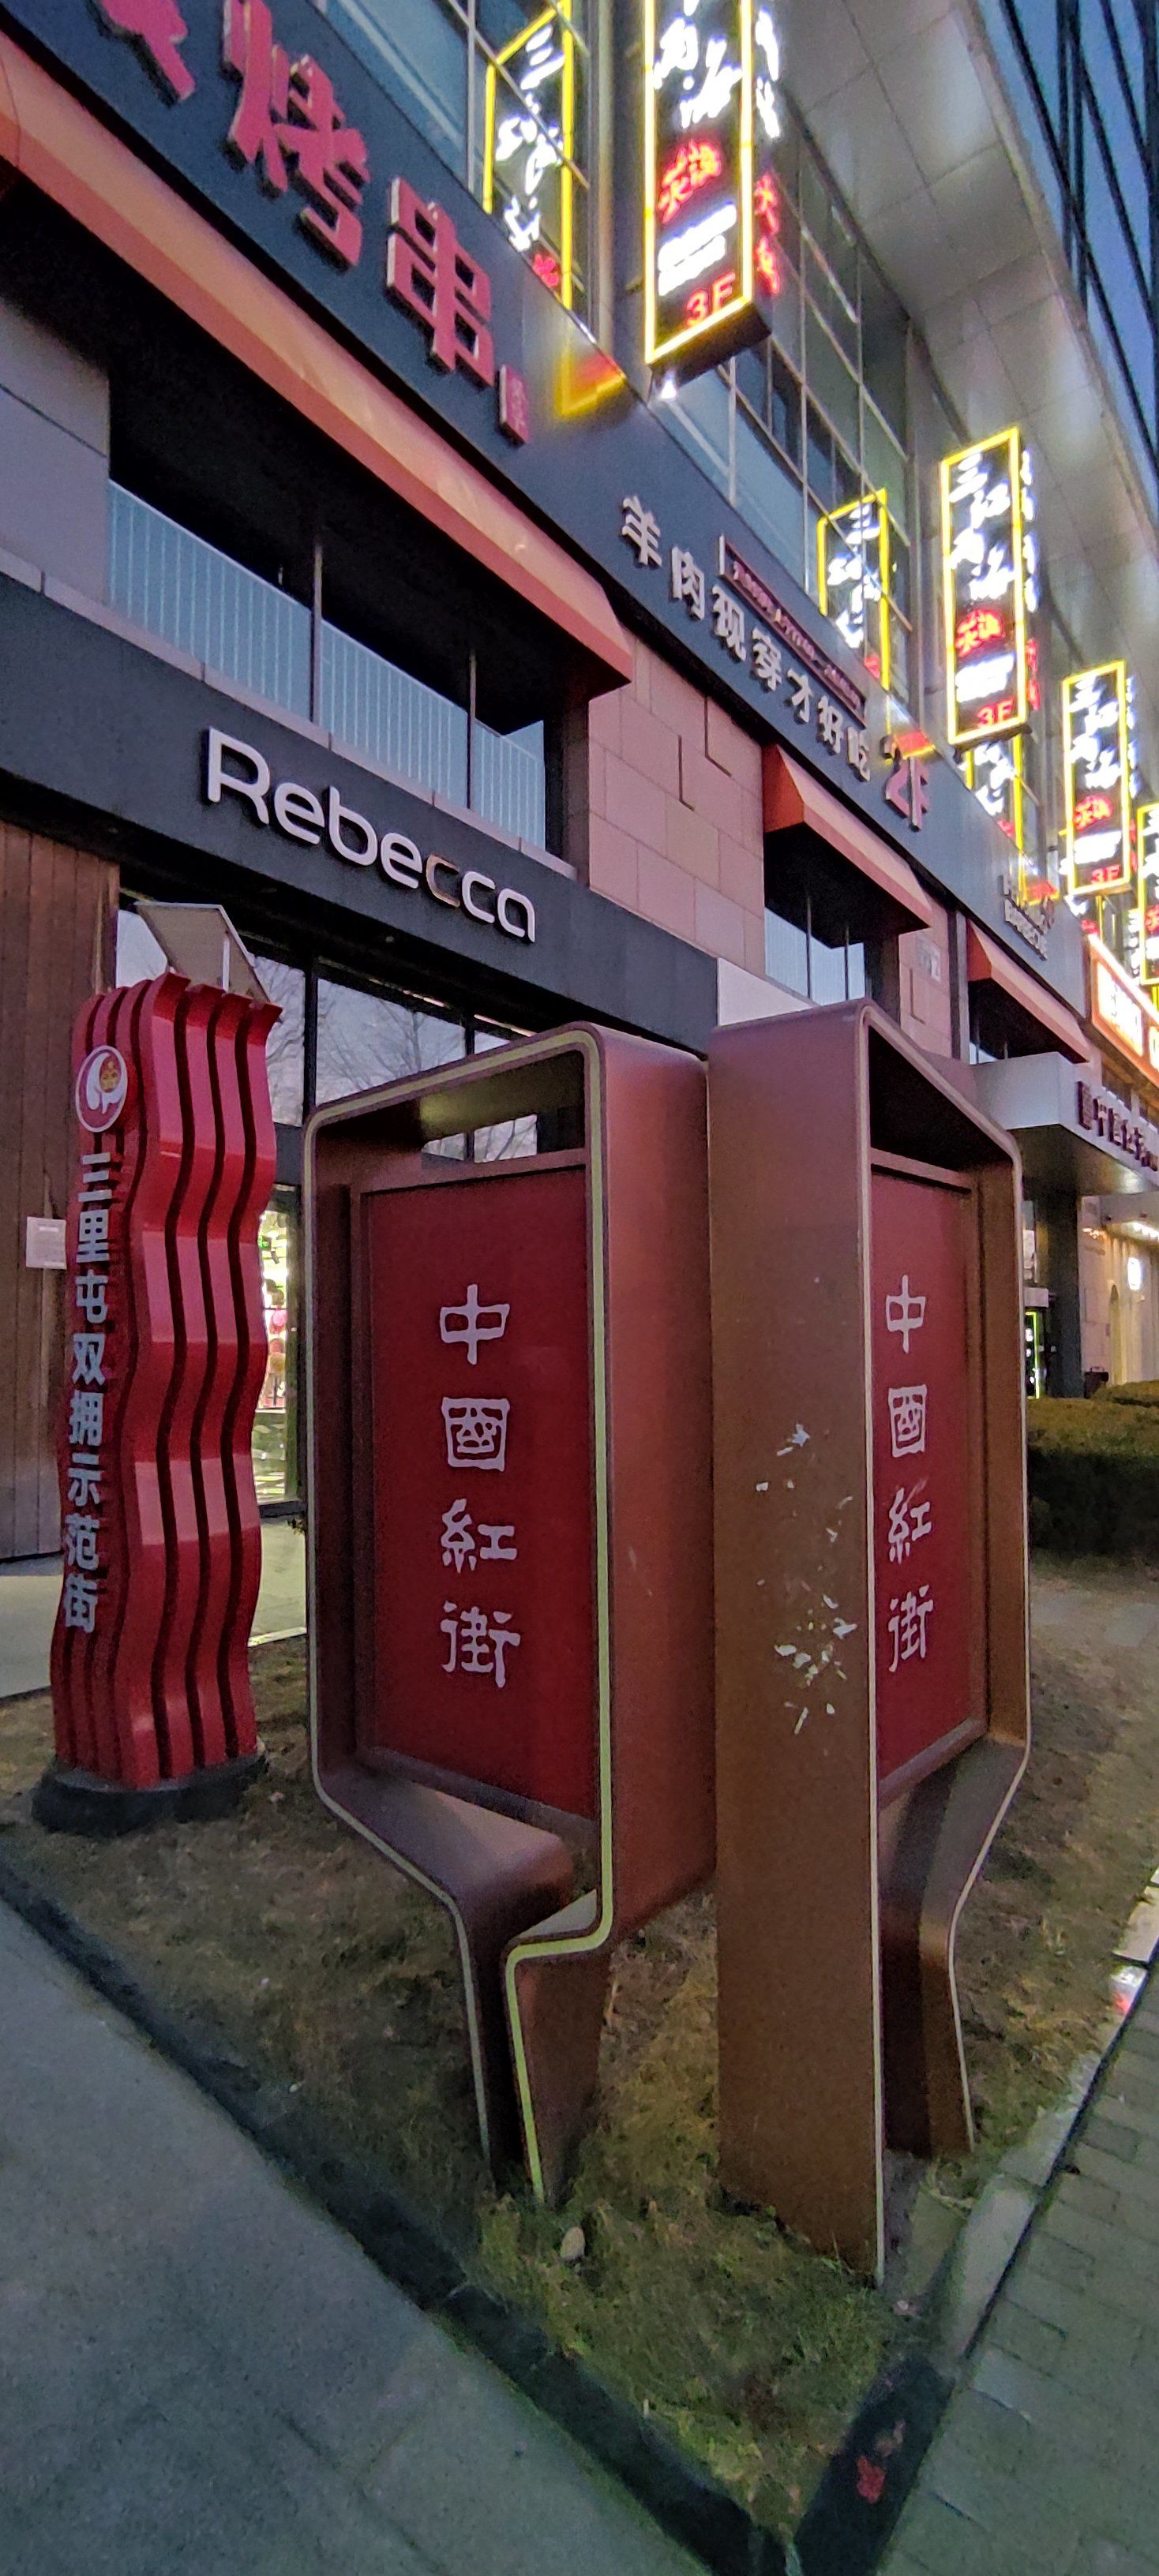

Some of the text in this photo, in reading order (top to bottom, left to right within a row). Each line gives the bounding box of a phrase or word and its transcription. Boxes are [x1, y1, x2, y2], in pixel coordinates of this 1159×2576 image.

[685, 271, 736, 328] 3F
[883, 734, 930, 831] 2F
[976, 698, 1015, 729] 3F
[207, 726, 536, 943] Rebecca
[1091, 863, 1121, 885] 3F
[65, 1151, 112, 1633] 三里屯双拥示范街
[440, 1283, 521, 1688] 中國紅街
[885, 1275, 933, 1672] 中國紅街
